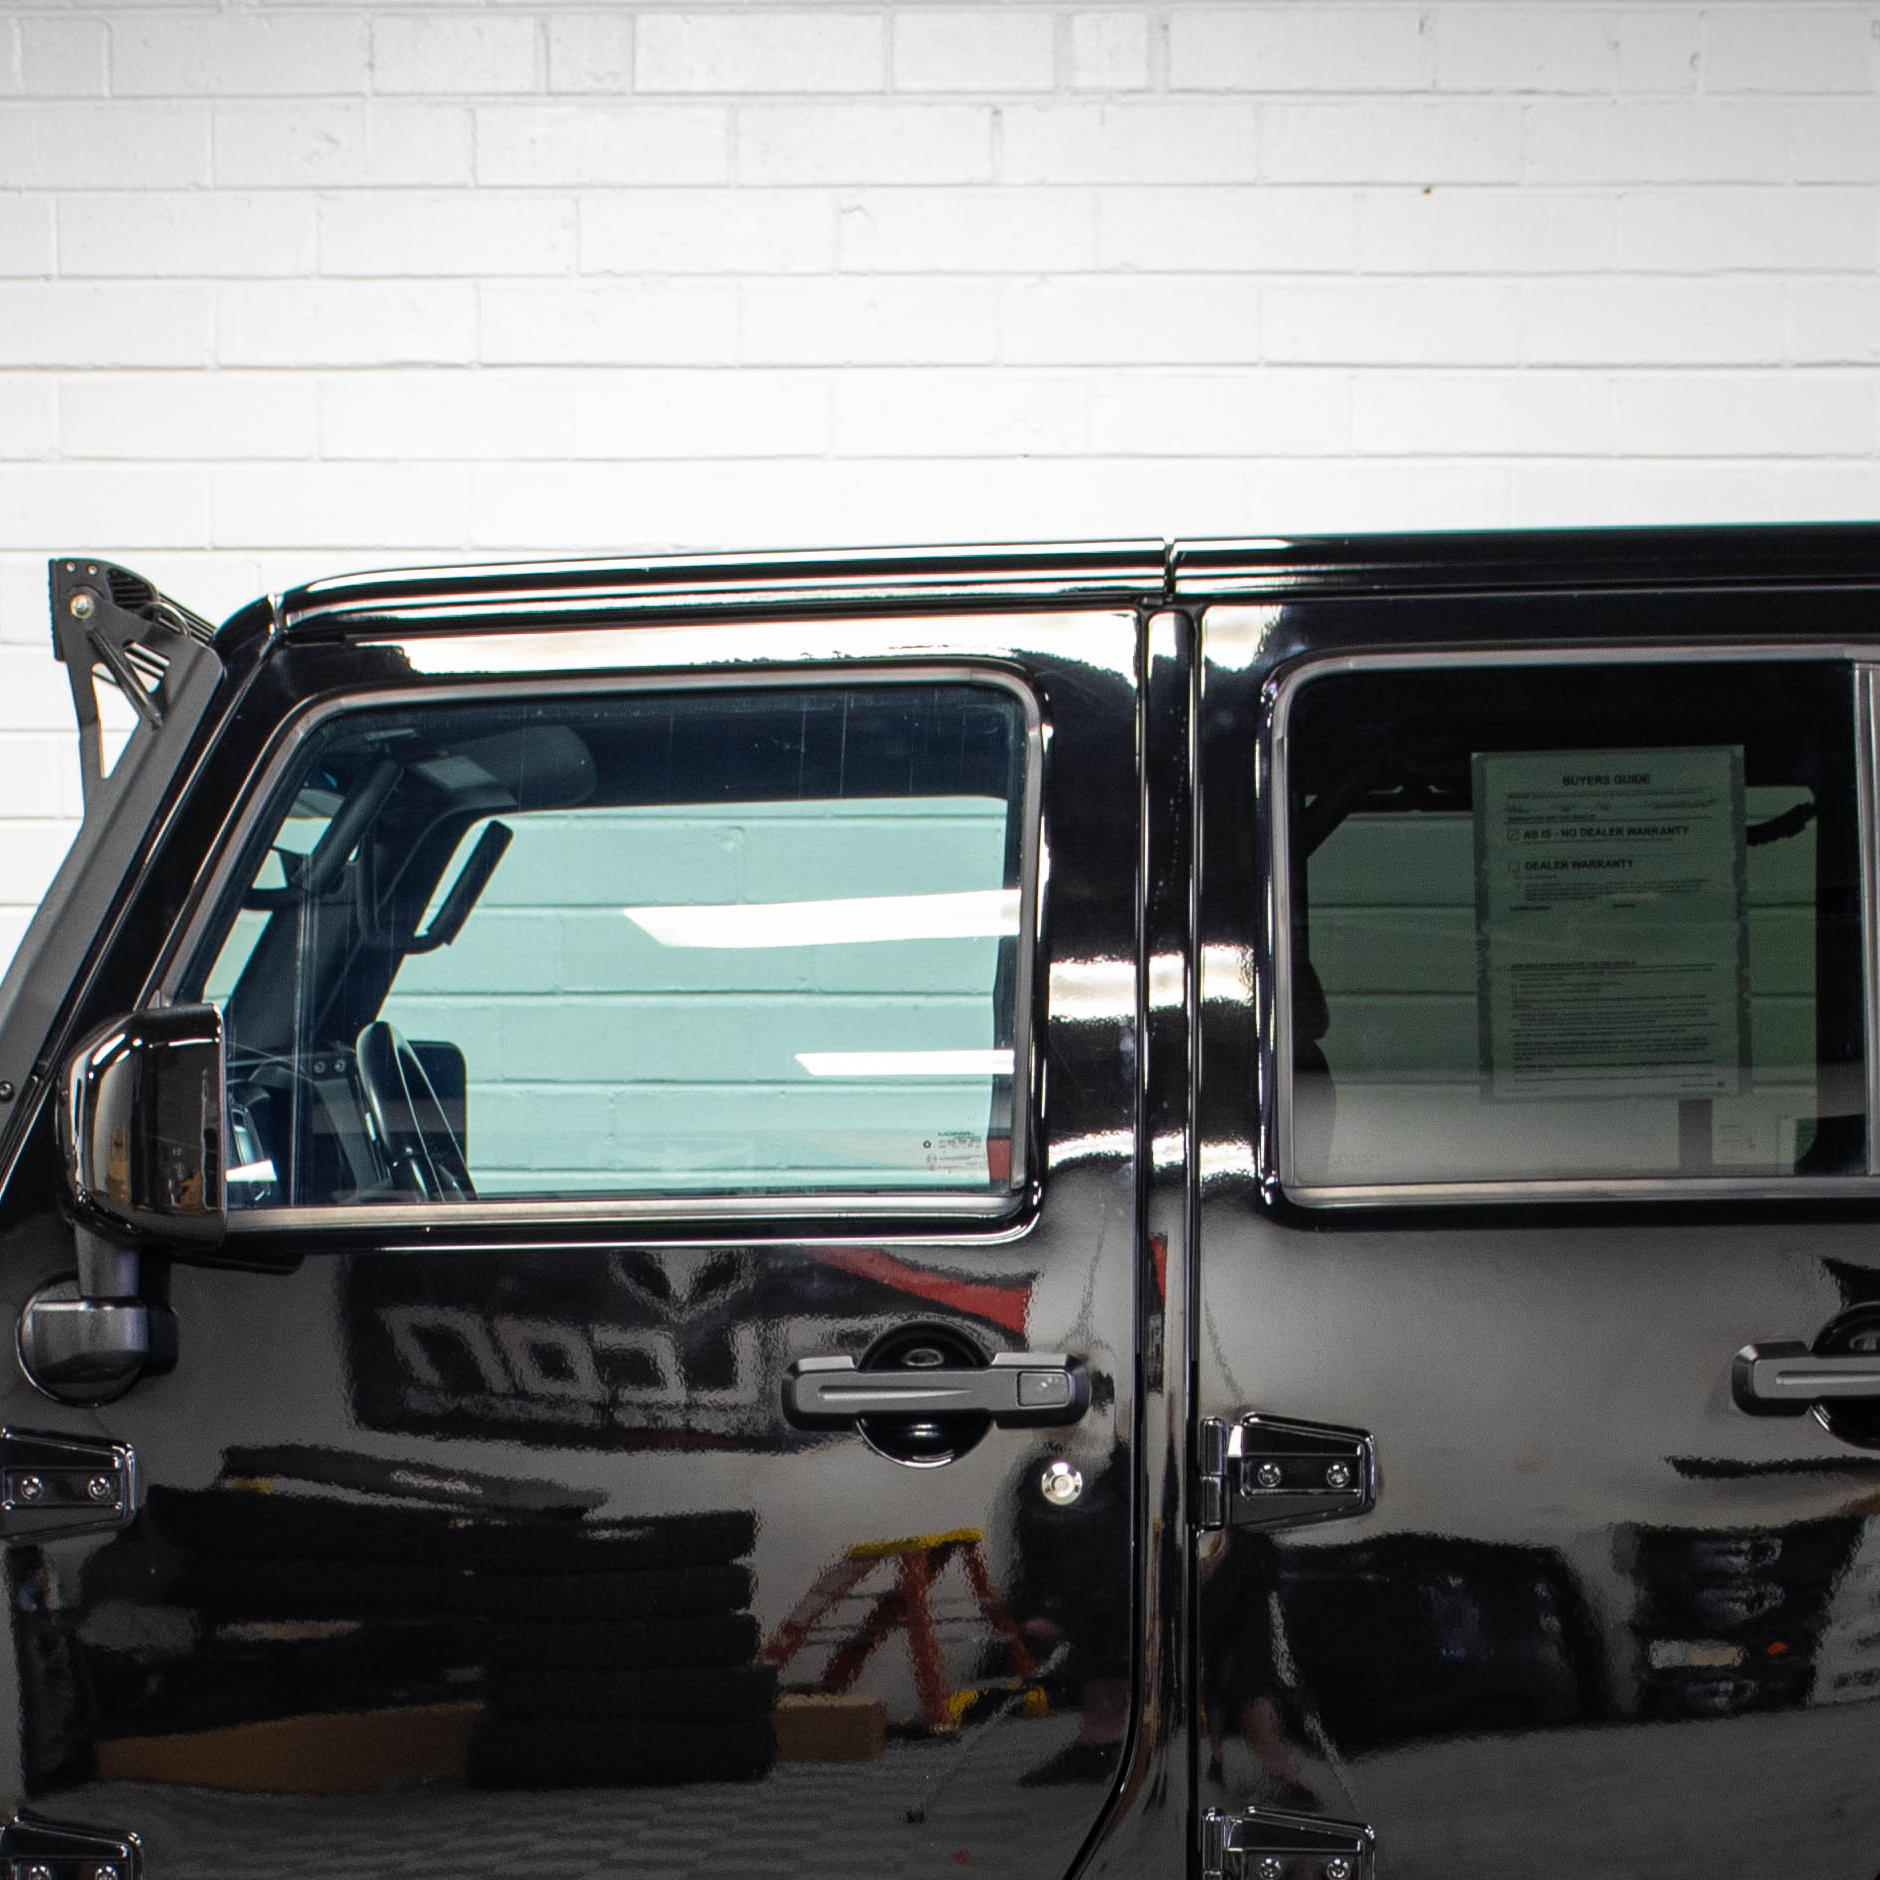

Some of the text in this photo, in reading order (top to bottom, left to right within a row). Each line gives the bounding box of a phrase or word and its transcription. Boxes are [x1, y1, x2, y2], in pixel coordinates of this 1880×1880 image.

[1562, 772, 1651, 787] BUYERS GUIDE
[1579, 826, 1625, 839] DEALER
[1626, 825, 1690, 838] WARRANTY
[1524, 857, 1634, 871] DEALER WARRANTY
